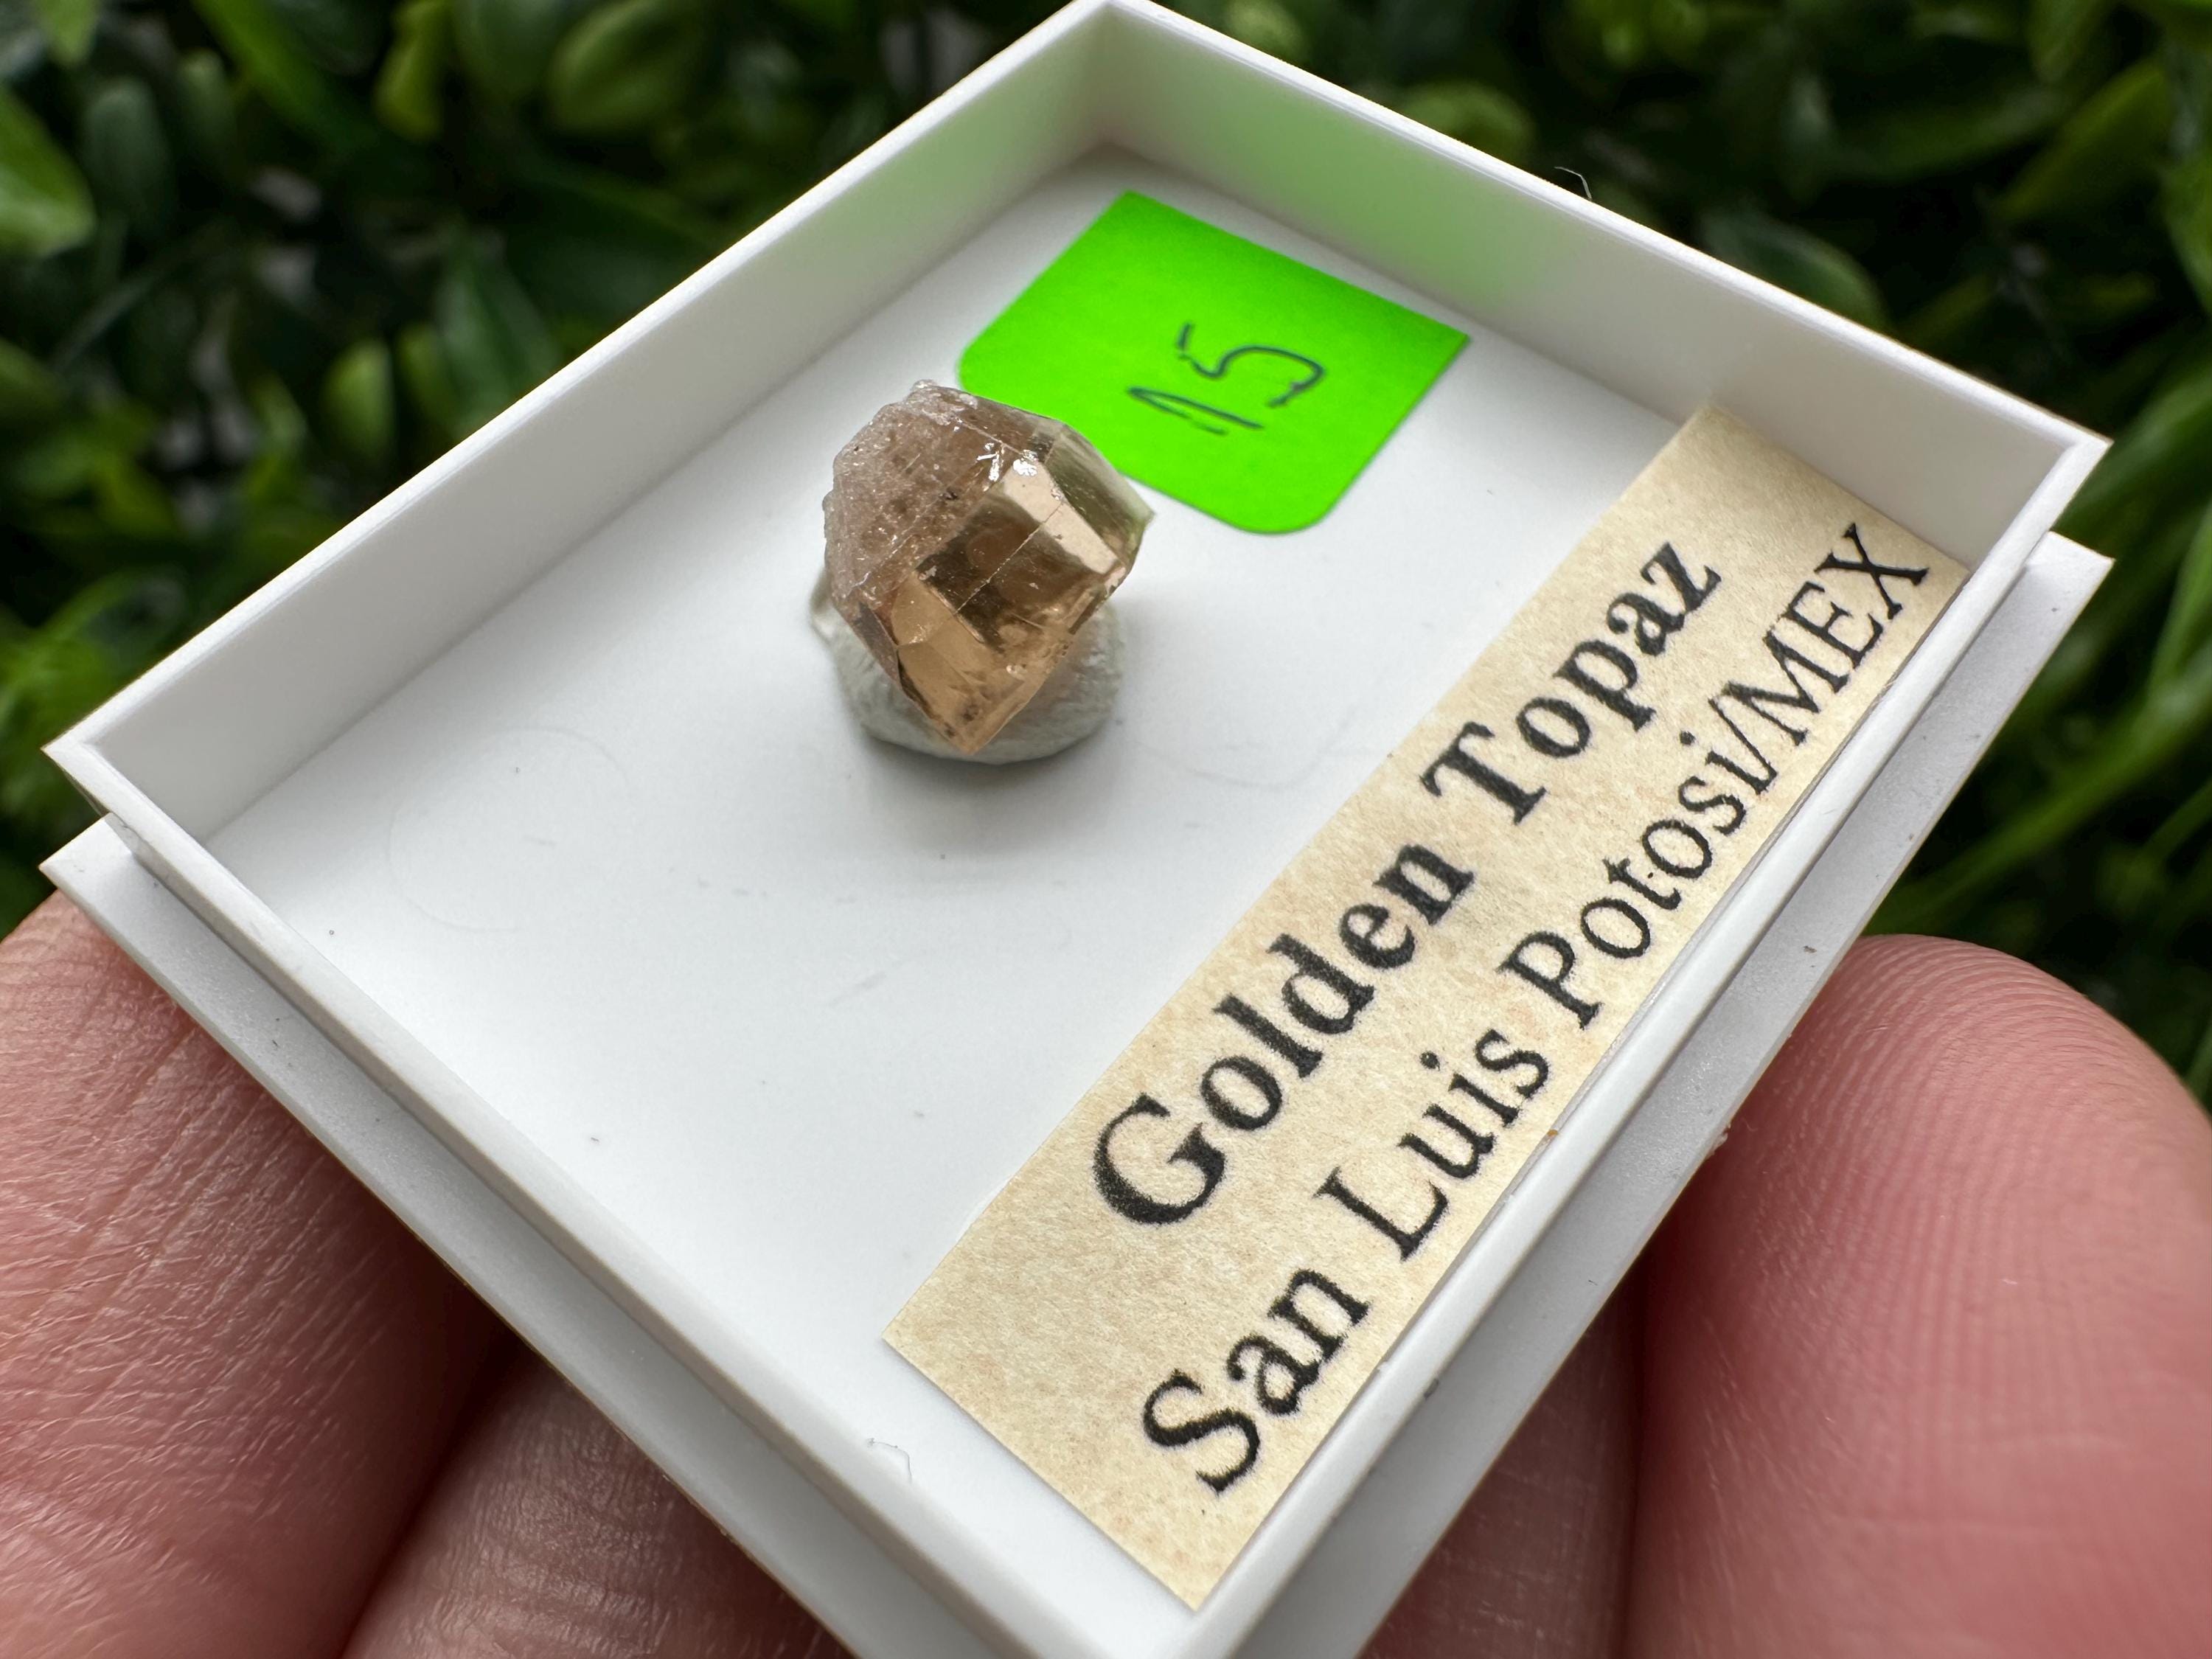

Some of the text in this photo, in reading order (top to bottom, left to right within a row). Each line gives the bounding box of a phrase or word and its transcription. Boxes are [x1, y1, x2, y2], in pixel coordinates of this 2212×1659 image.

[1127, 322, 1326, 434] 15
[1091, 540, 1722, 1226] Golden Topaz
[1142, 521, 1931, 1496] San Luis Potosi/MEX
